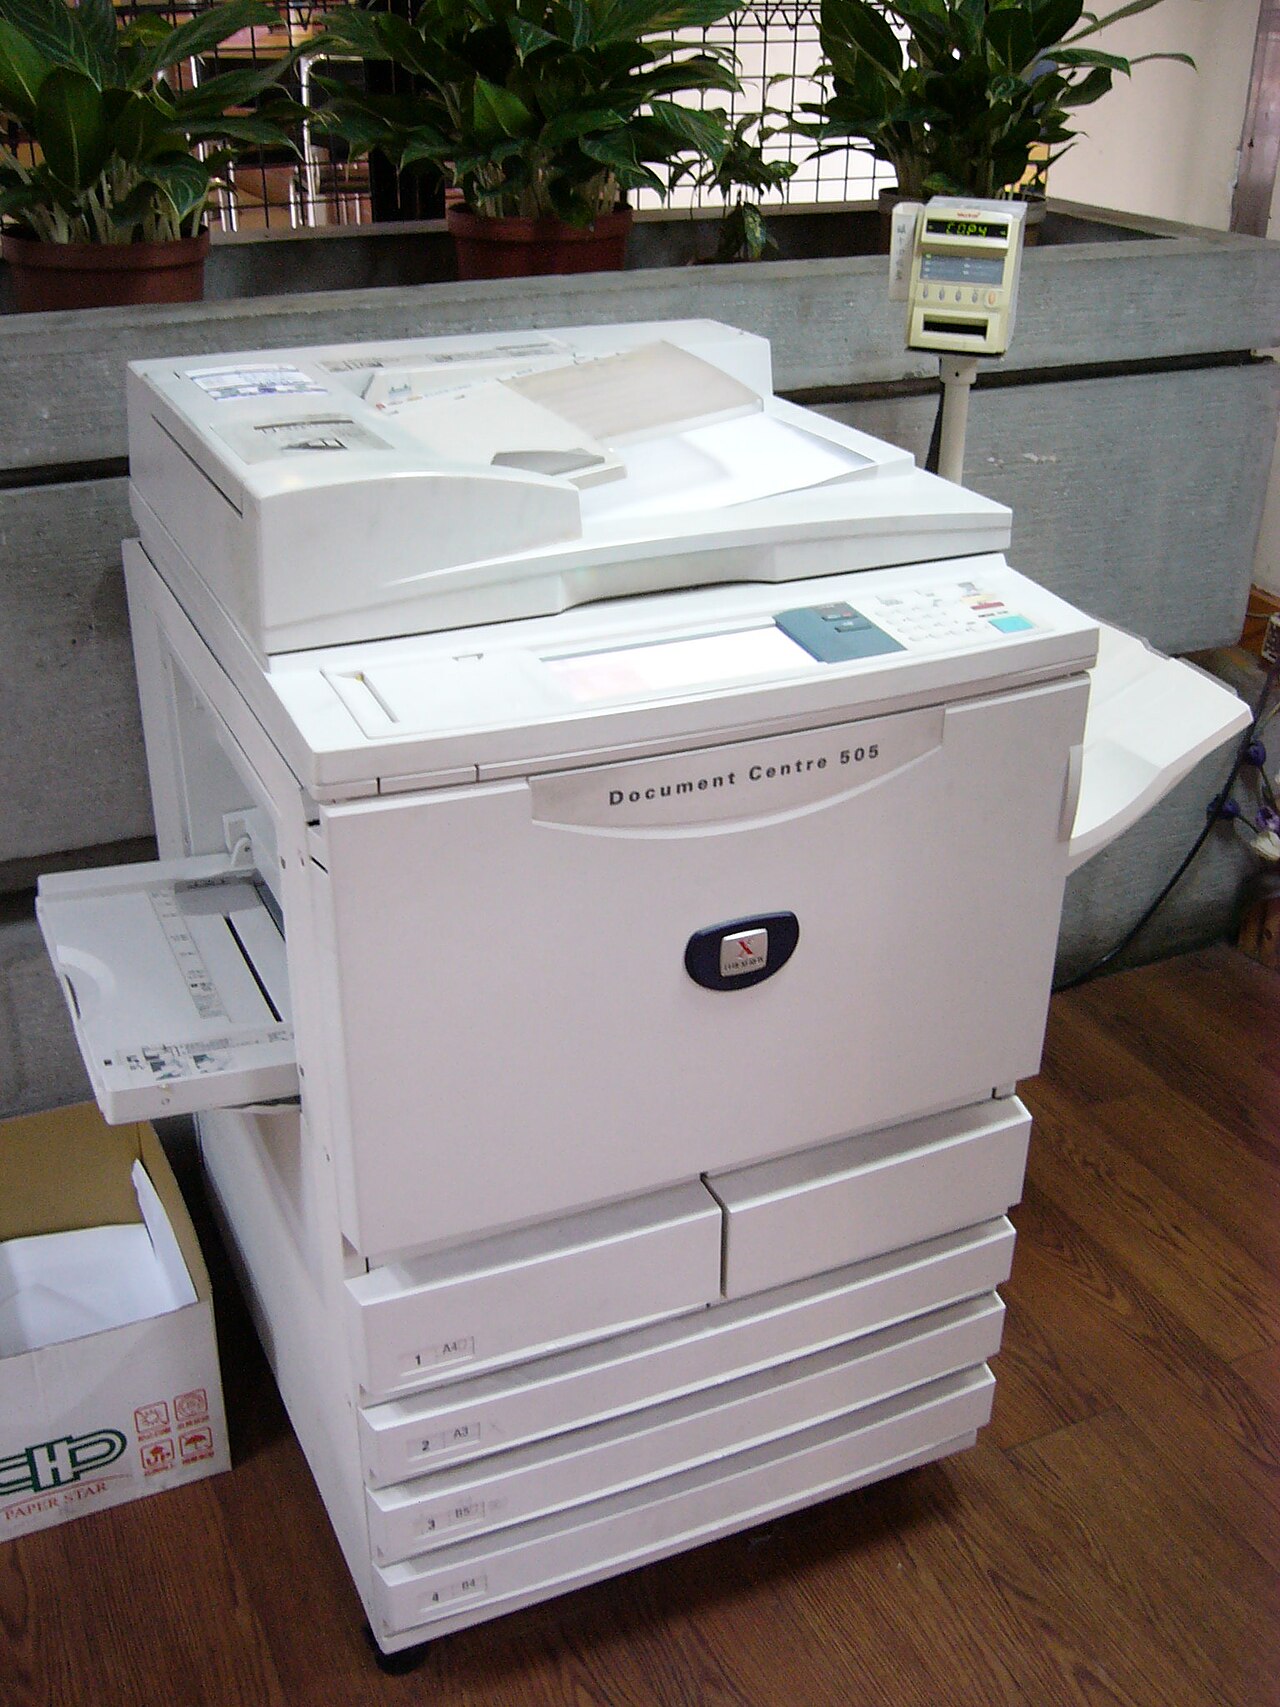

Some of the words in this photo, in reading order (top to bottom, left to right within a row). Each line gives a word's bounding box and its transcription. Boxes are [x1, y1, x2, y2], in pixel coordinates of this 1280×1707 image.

[608, 771, 736, 806] Document
[748, 756, 828, 782] Centre
[839, 743, 880, 765] 505
[415, 1354, 421, 1366] 1
[421, 1440, 430, 1451] 2
[5, 1498, 60, 1521] PAPER
[66, 1482, 108, 1503] STAR
